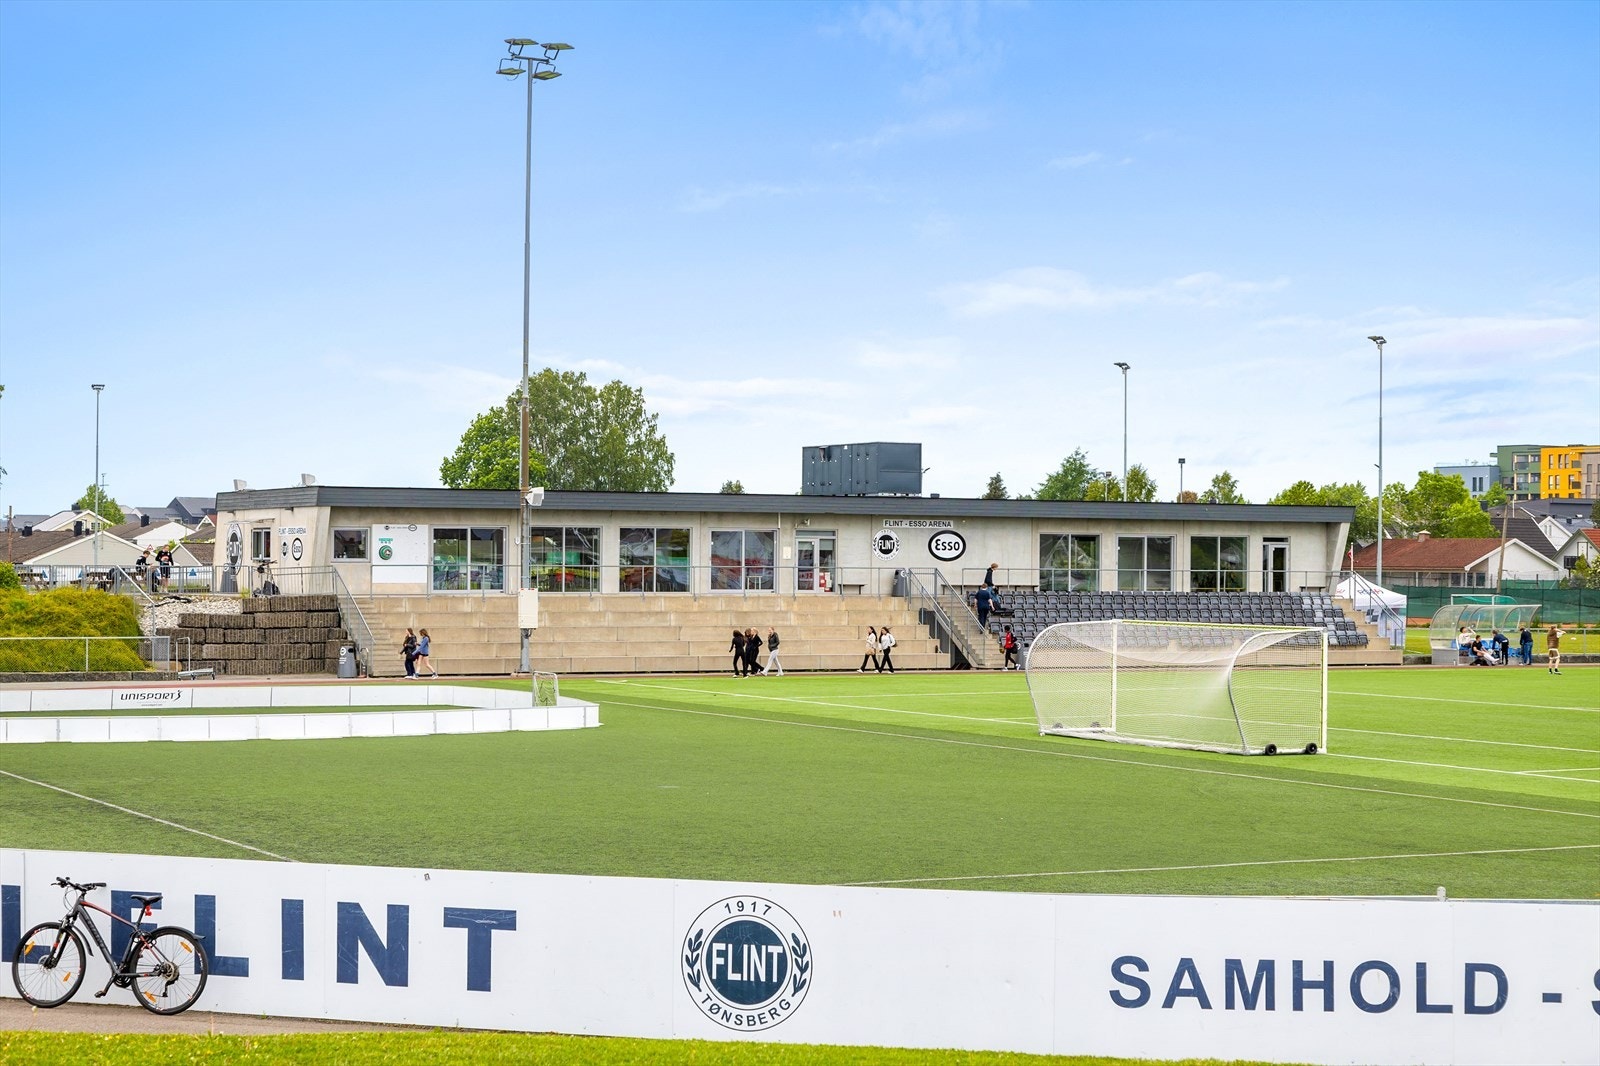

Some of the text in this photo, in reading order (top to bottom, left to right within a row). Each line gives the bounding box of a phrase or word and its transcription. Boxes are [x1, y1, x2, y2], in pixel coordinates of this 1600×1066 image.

[908, 520, 928, 528] ESSO
[928, 520, 952, 528] ARENA
[878, 539, 895, 550] FLINT
[120, 692, 177, 701] UNISPORT
[724, 900, 772, 916] 1917
[110, 890, 517, 992] FLINT
[711, 942, 784, 983] FLINT
[1108, 955, 1563, 1015] SAMHOLD -
[701, 993, 791, 1027] TØNSBERG
